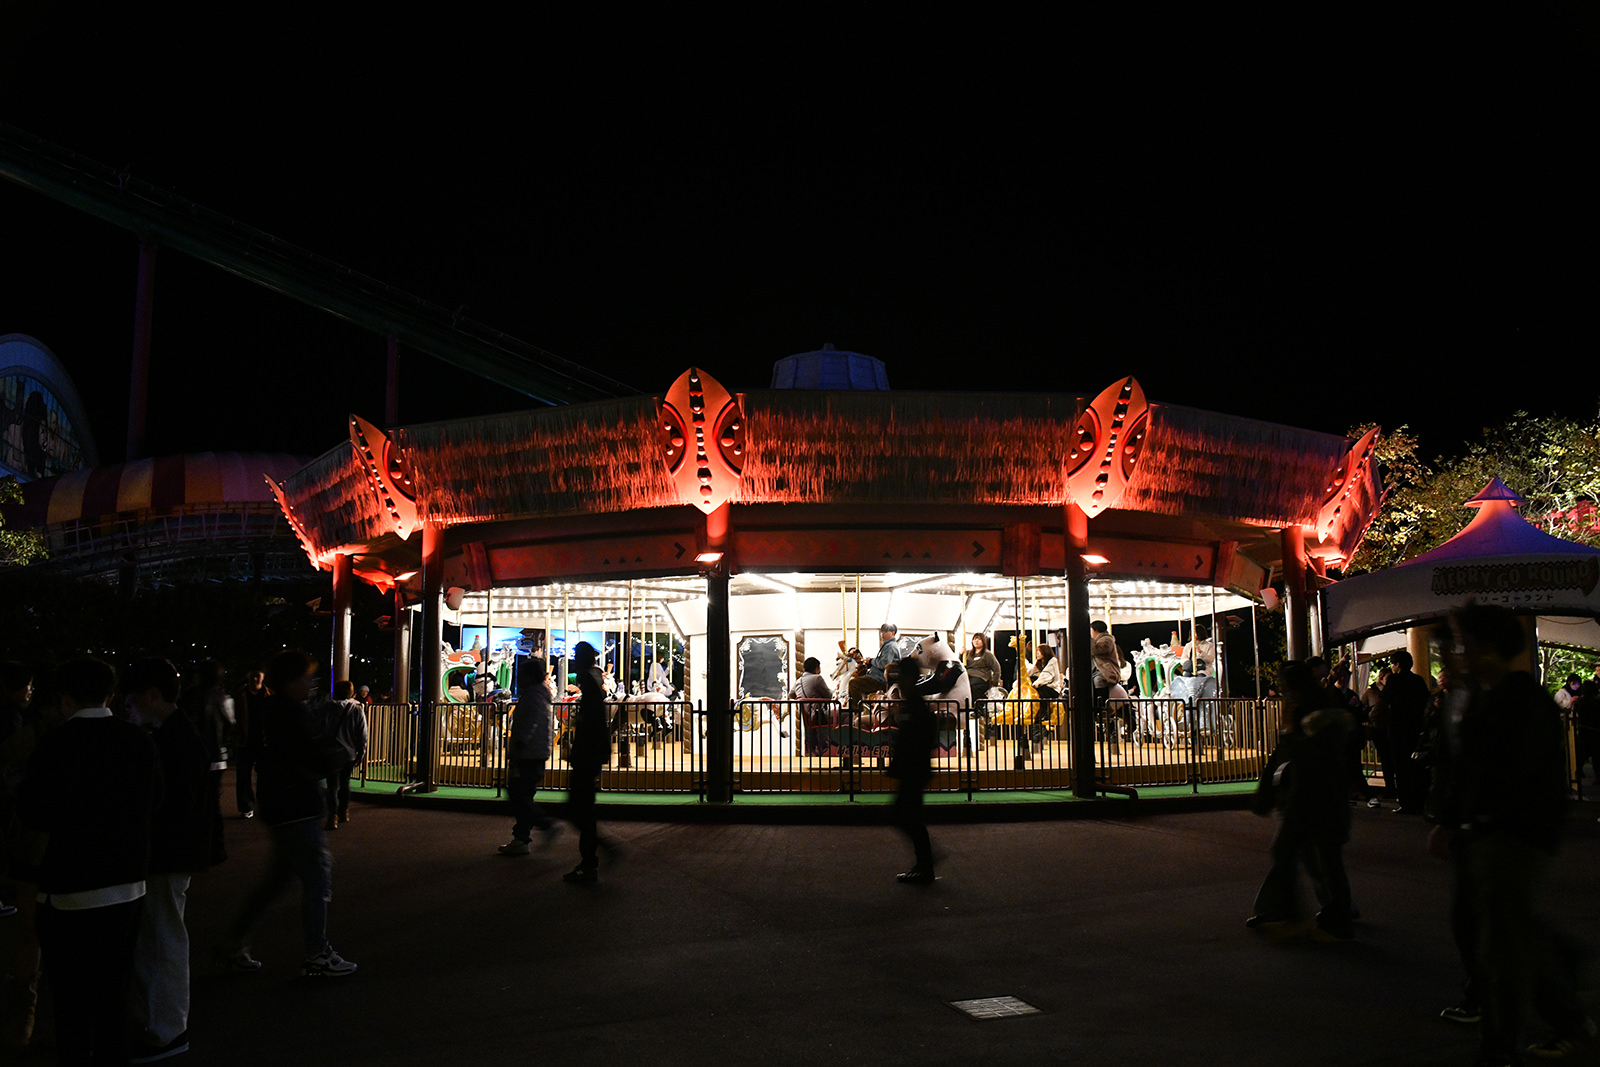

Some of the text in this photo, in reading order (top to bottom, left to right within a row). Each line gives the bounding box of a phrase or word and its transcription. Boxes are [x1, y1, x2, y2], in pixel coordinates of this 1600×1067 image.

[1432, 562, 1589, 590] MERRY GO ROUND
